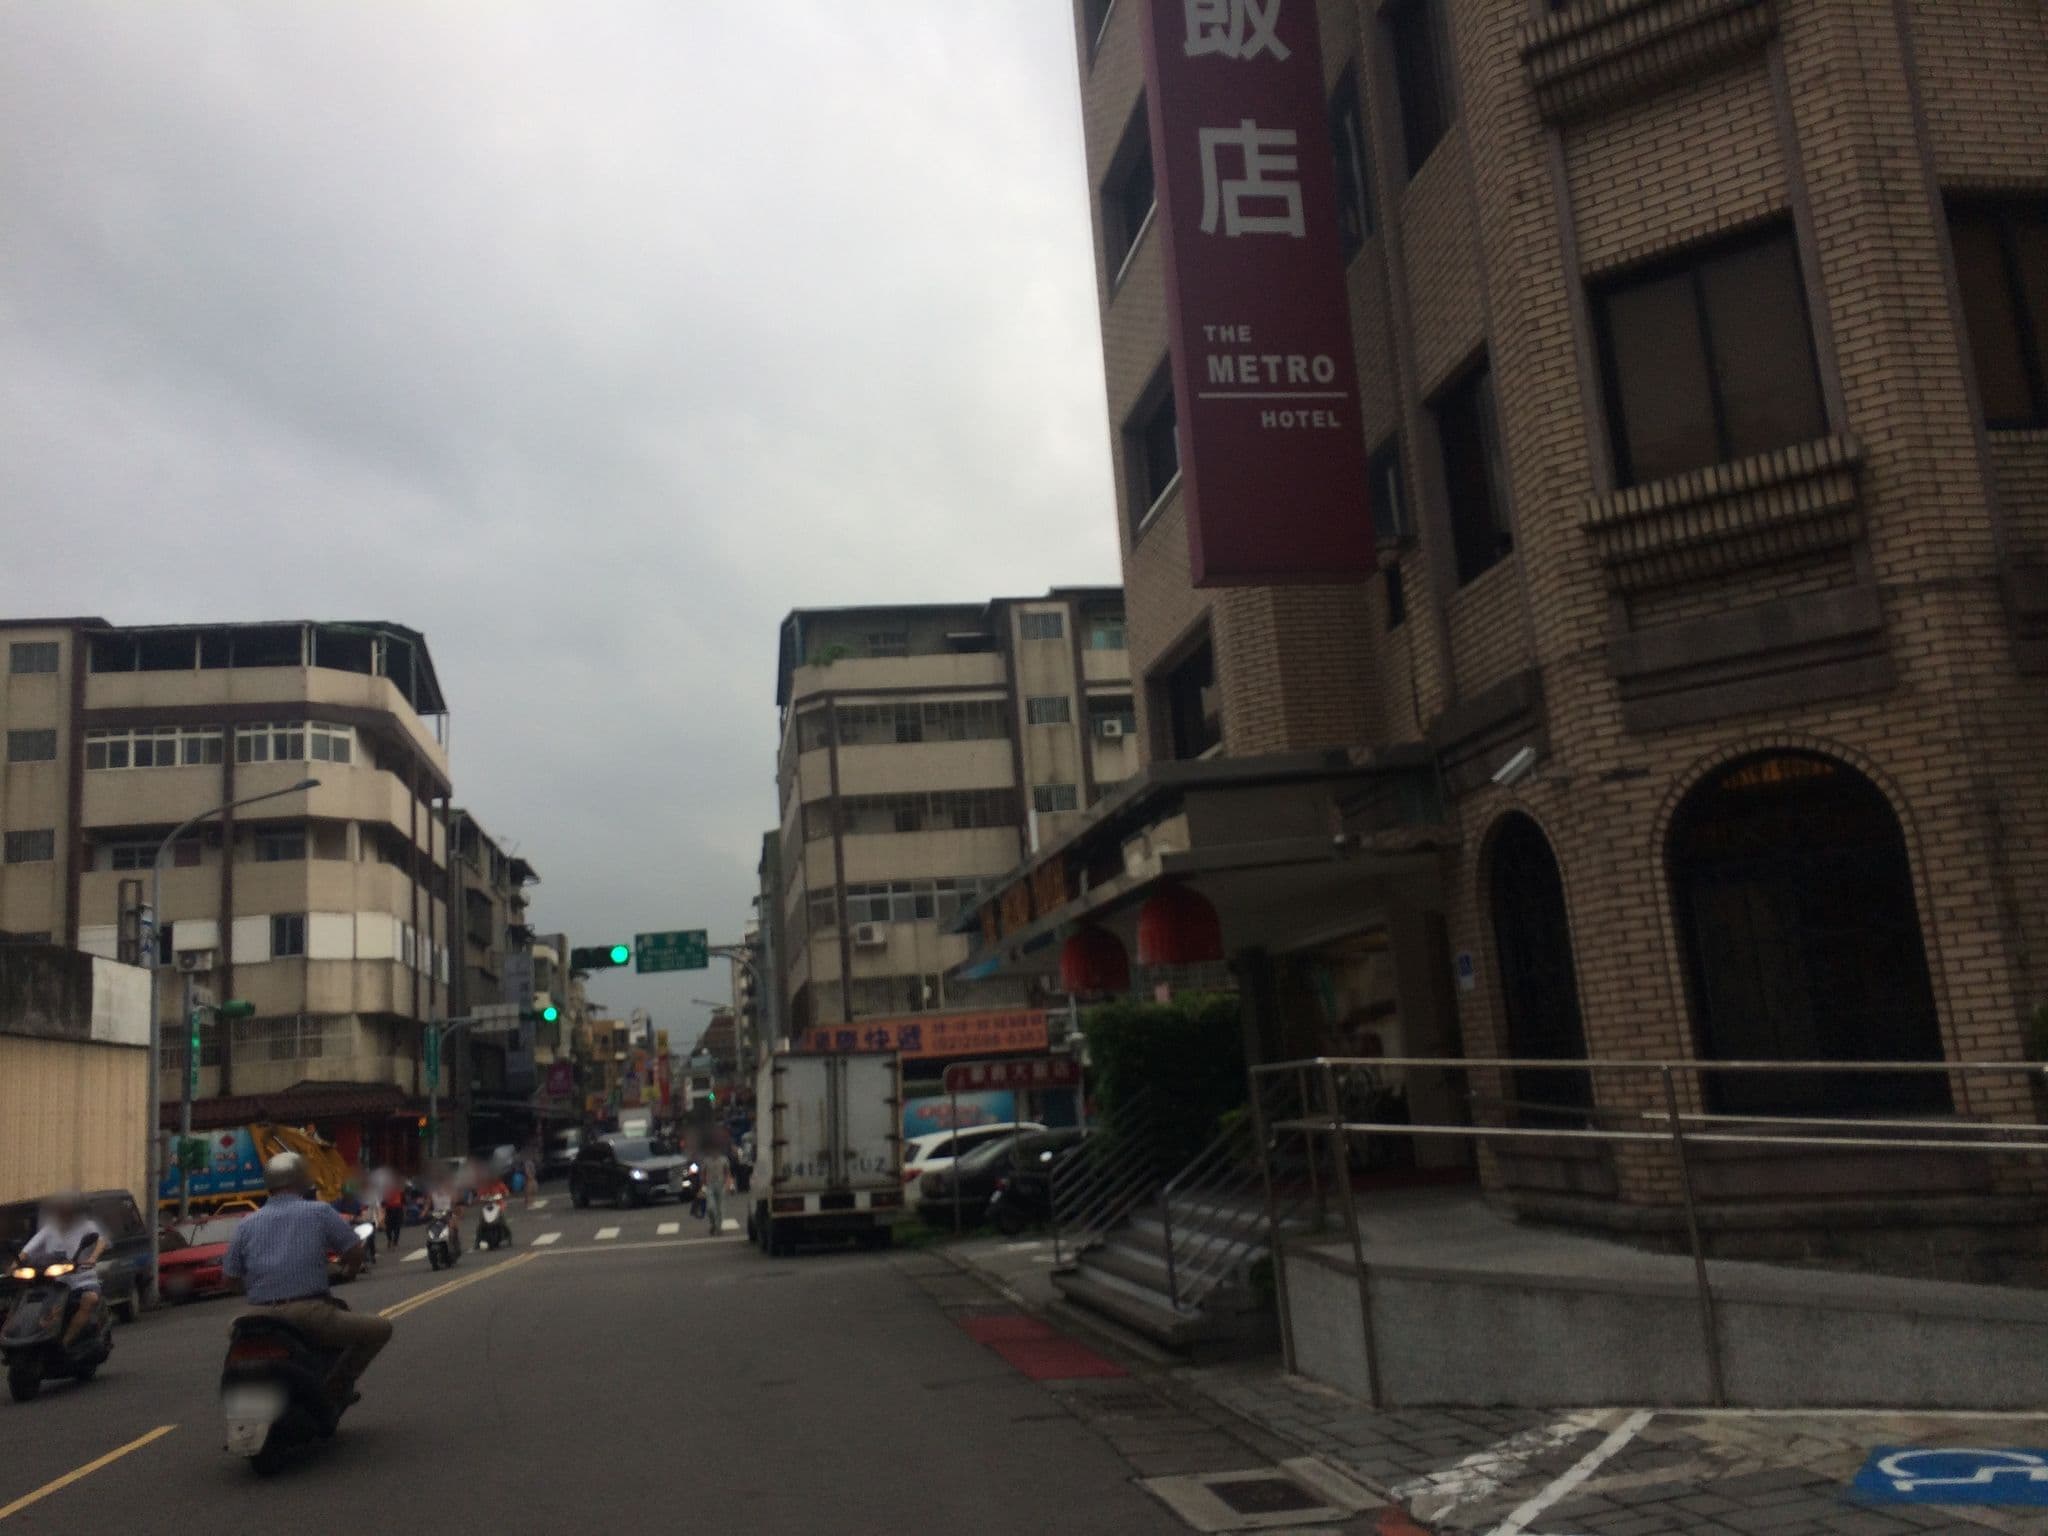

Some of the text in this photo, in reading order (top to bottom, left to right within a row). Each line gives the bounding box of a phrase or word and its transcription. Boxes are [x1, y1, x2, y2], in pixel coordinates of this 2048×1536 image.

[1203, 325, 1253, 343] THE
[1207, 354, 1336, 385] METRO
[1260, 410, 1343, 429] HOTEL
